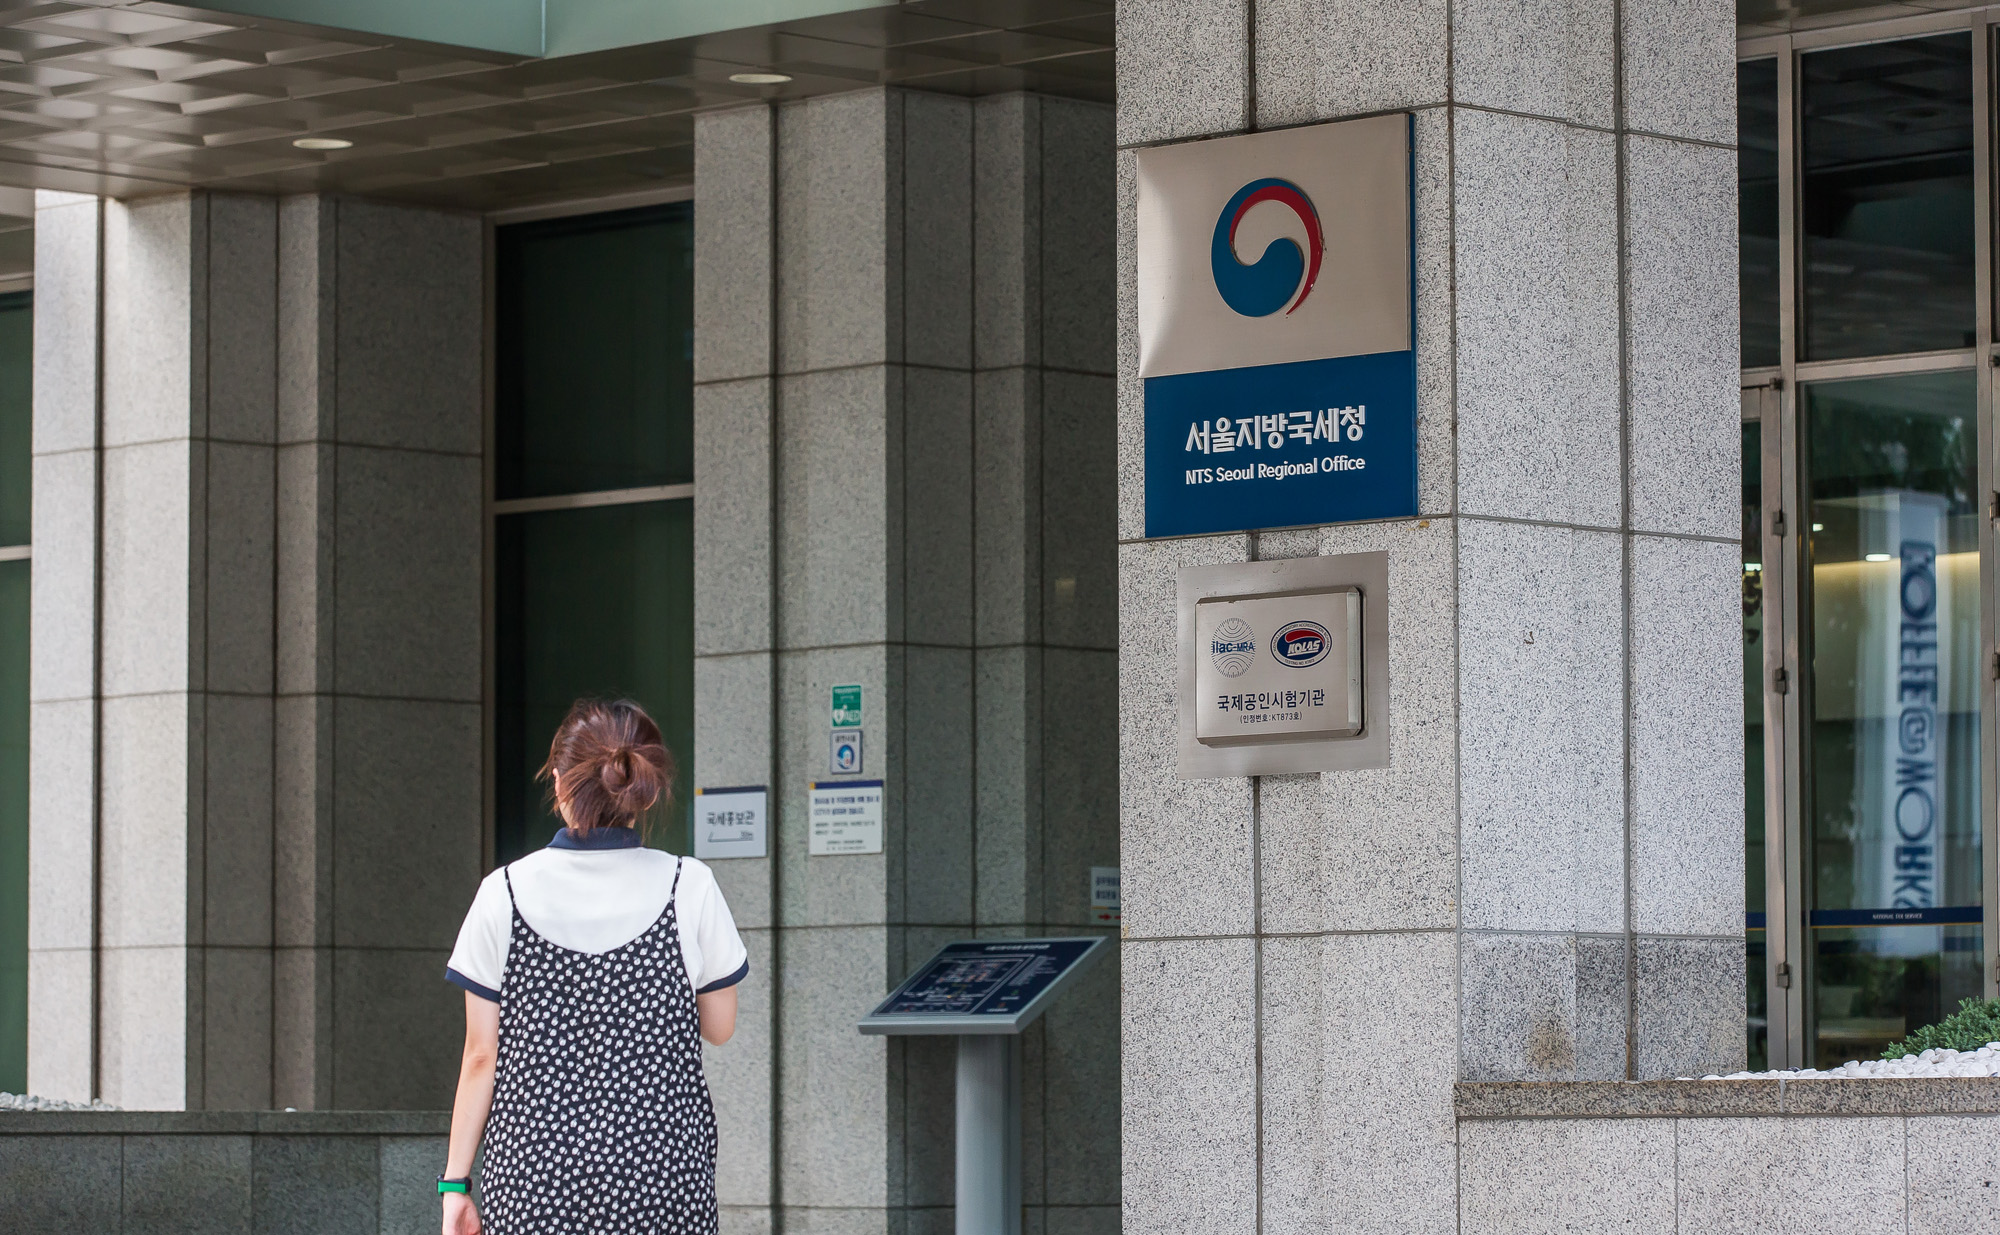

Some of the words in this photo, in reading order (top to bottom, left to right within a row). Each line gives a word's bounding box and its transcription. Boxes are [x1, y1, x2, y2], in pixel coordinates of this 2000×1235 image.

[1185, 405, 1366, 455] 서울지방국세청
[1185, 467, 1214, 485] NTS
[1216, 463, 1254, 482] Seoul
[1258, 457, 1318, 481] Regional
[1321, 455, 1366, 473] Office
[1212, 641, 1255, 654] ilac-MRA
[1287, 639, 1321, 655] KOLAS
[1217, 688, 1326, 712] 국제공인시험기관
